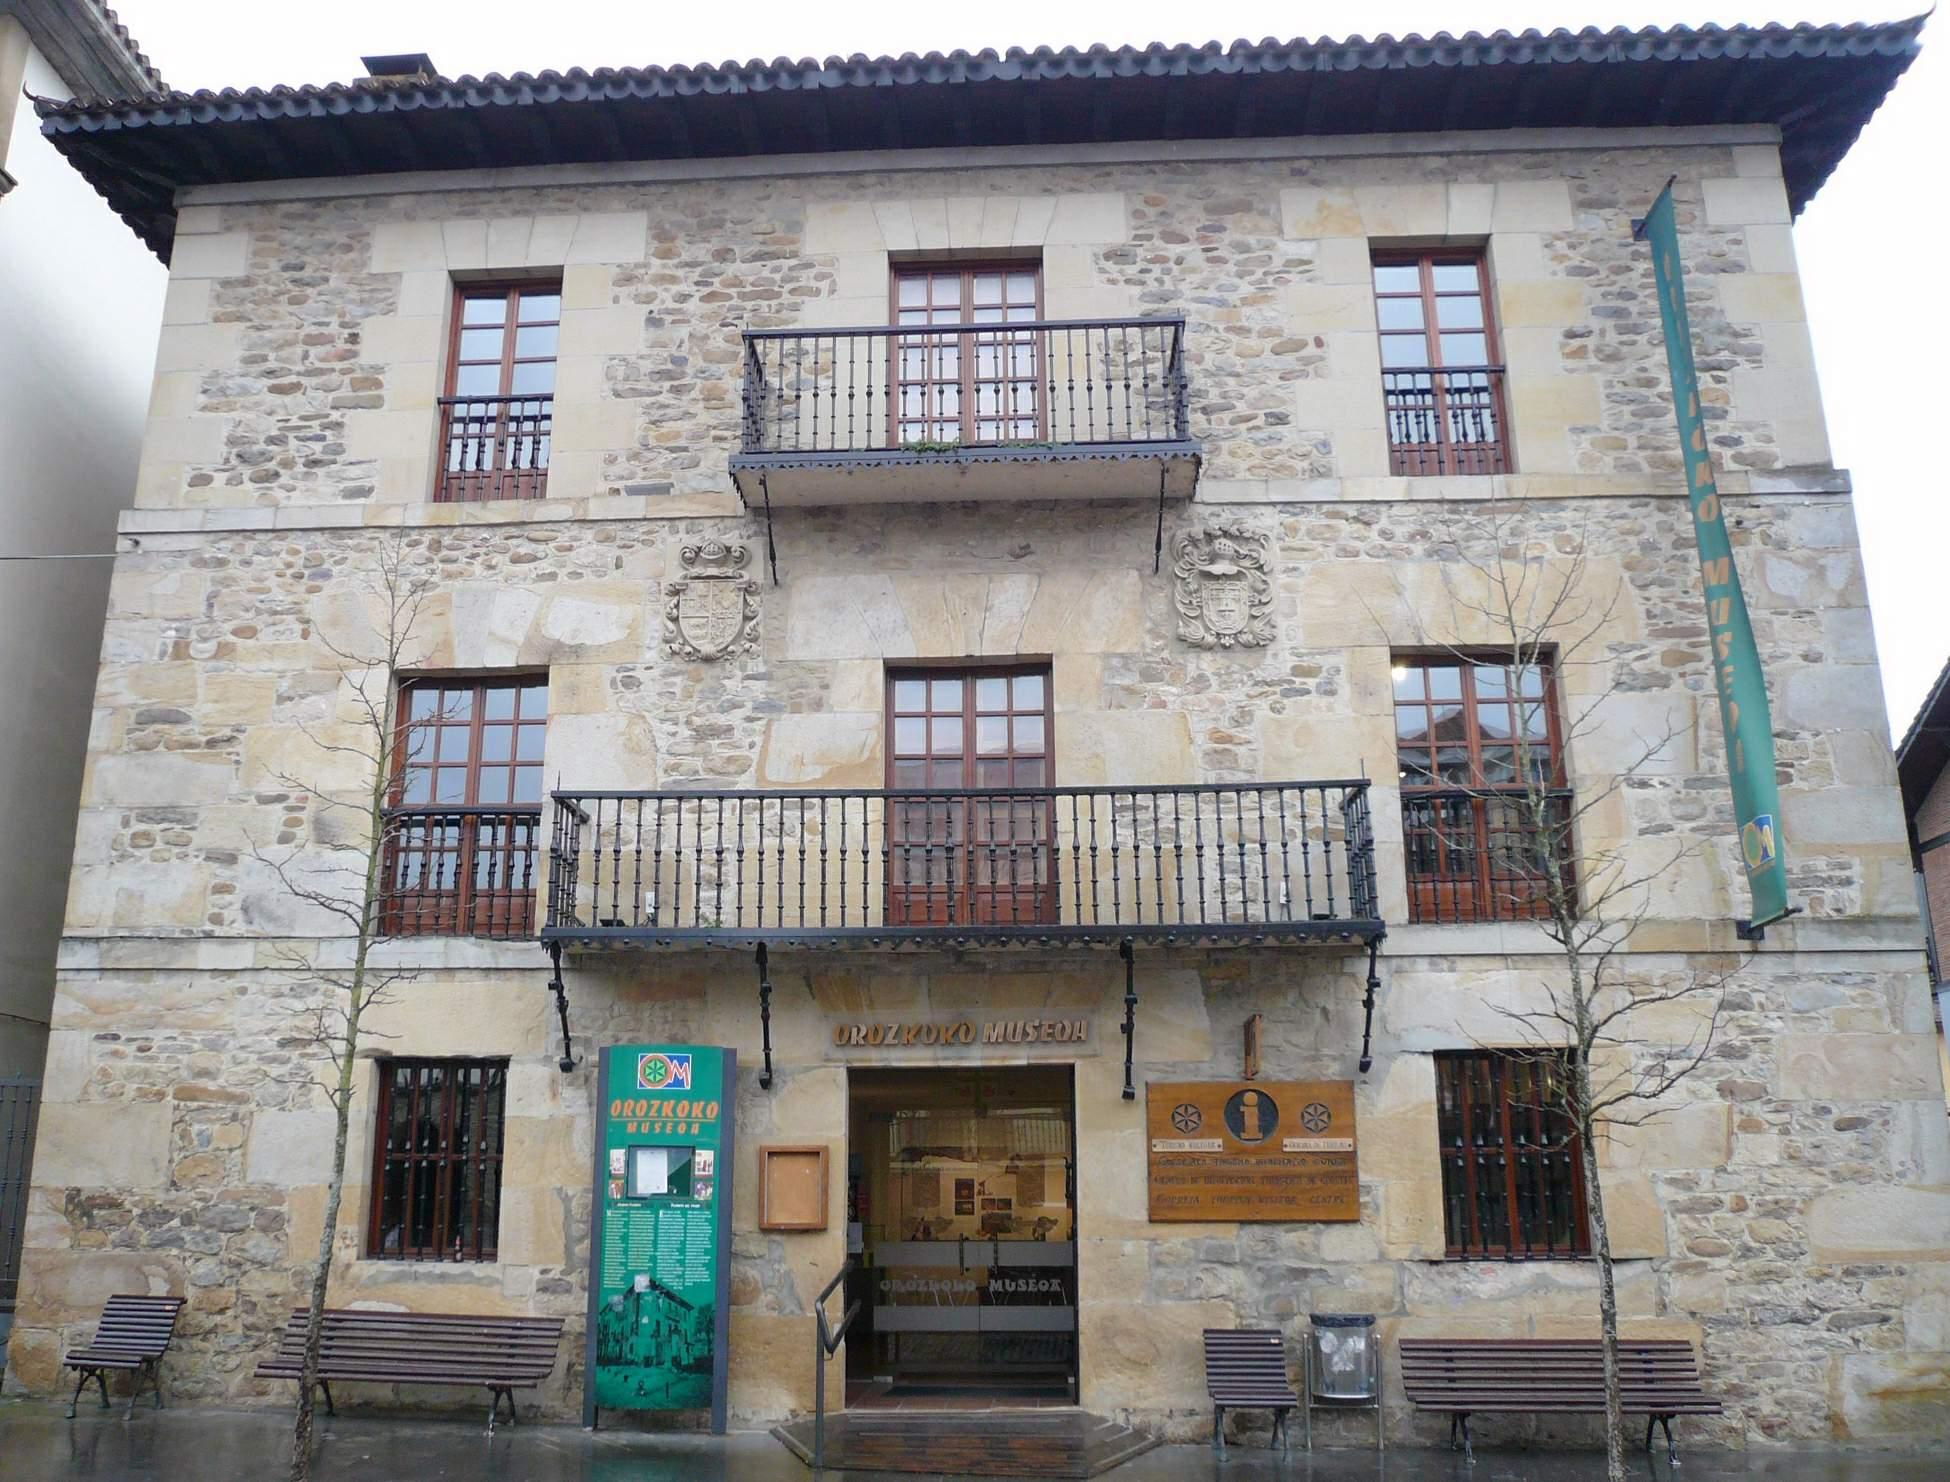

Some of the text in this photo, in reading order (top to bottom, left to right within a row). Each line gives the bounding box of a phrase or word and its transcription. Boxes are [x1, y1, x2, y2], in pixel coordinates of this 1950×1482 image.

[832, 1018, 1089, 1046] OROZKOKO MUSEOA
[611, 1099, 719, 1119] OROZKOKO
[627, 1121, 700, 1135] MUSEOA
